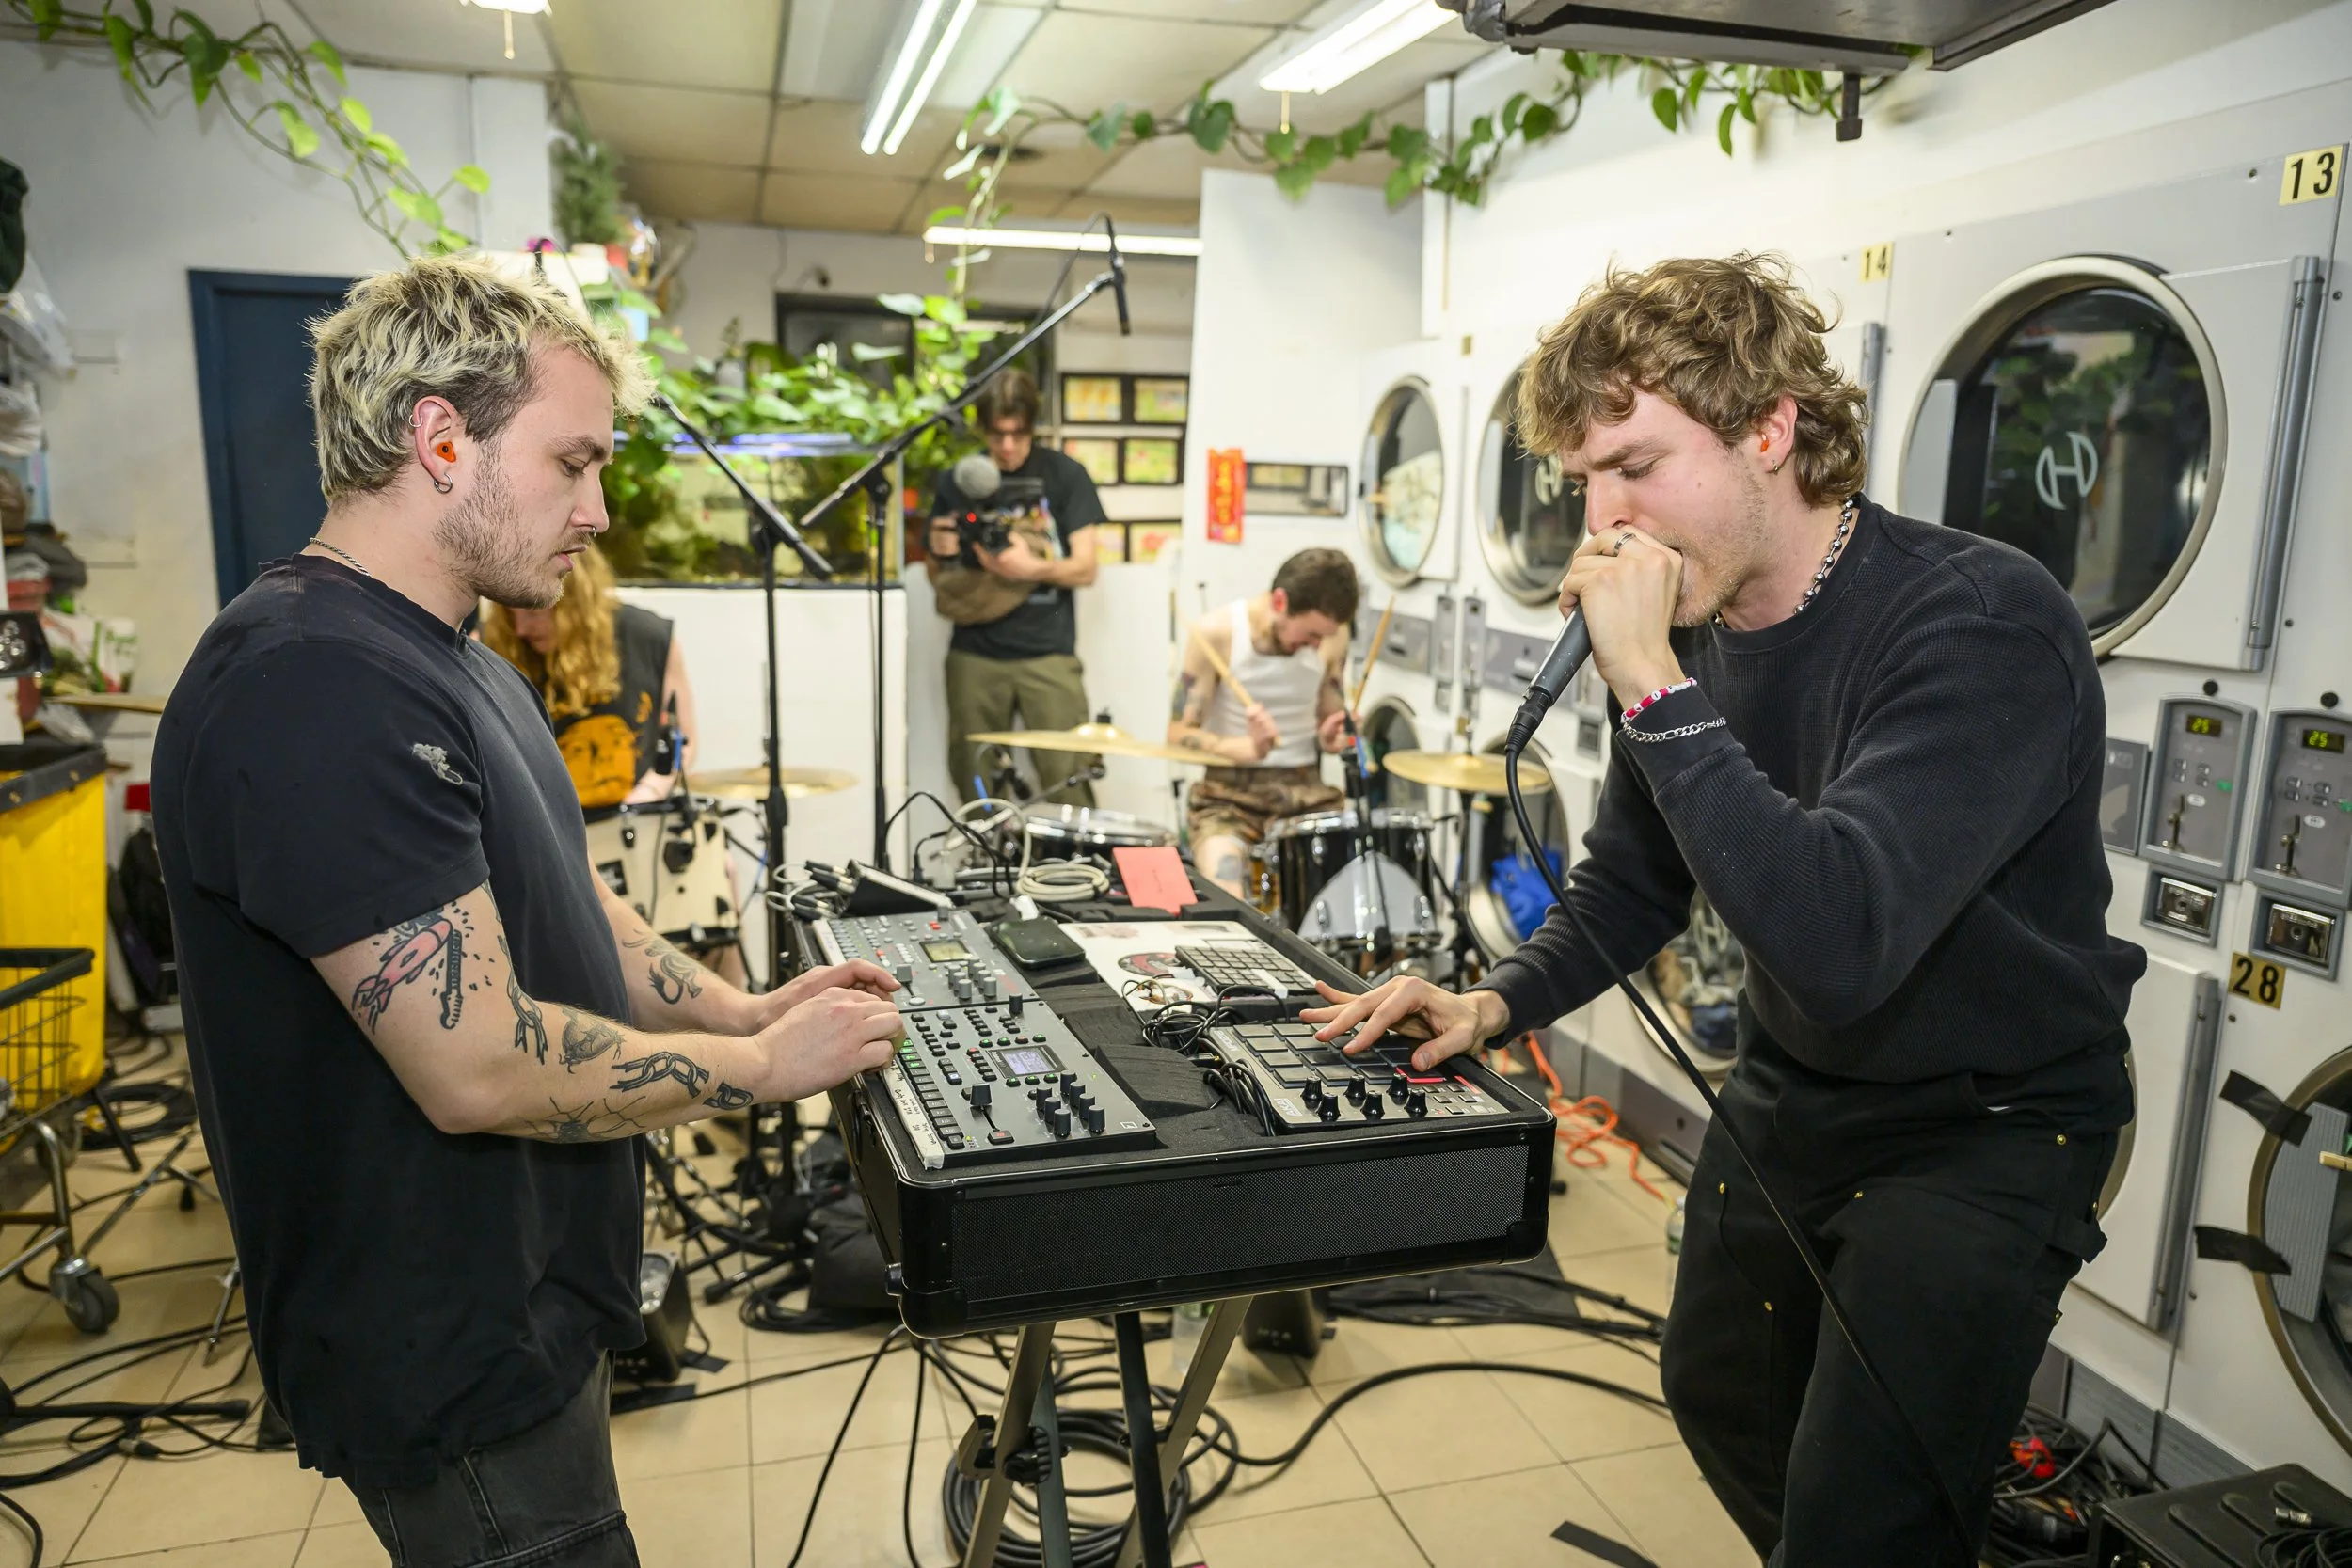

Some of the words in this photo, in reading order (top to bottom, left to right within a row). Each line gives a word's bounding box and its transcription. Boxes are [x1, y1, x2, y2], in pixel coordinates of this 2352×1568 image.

[2291, 152, 2335, 199] 13
[1865, 246, 1888, 280] 14
[2308, 730, 2329, 749] 25
[2233, 958, 2279, 1004] 28
